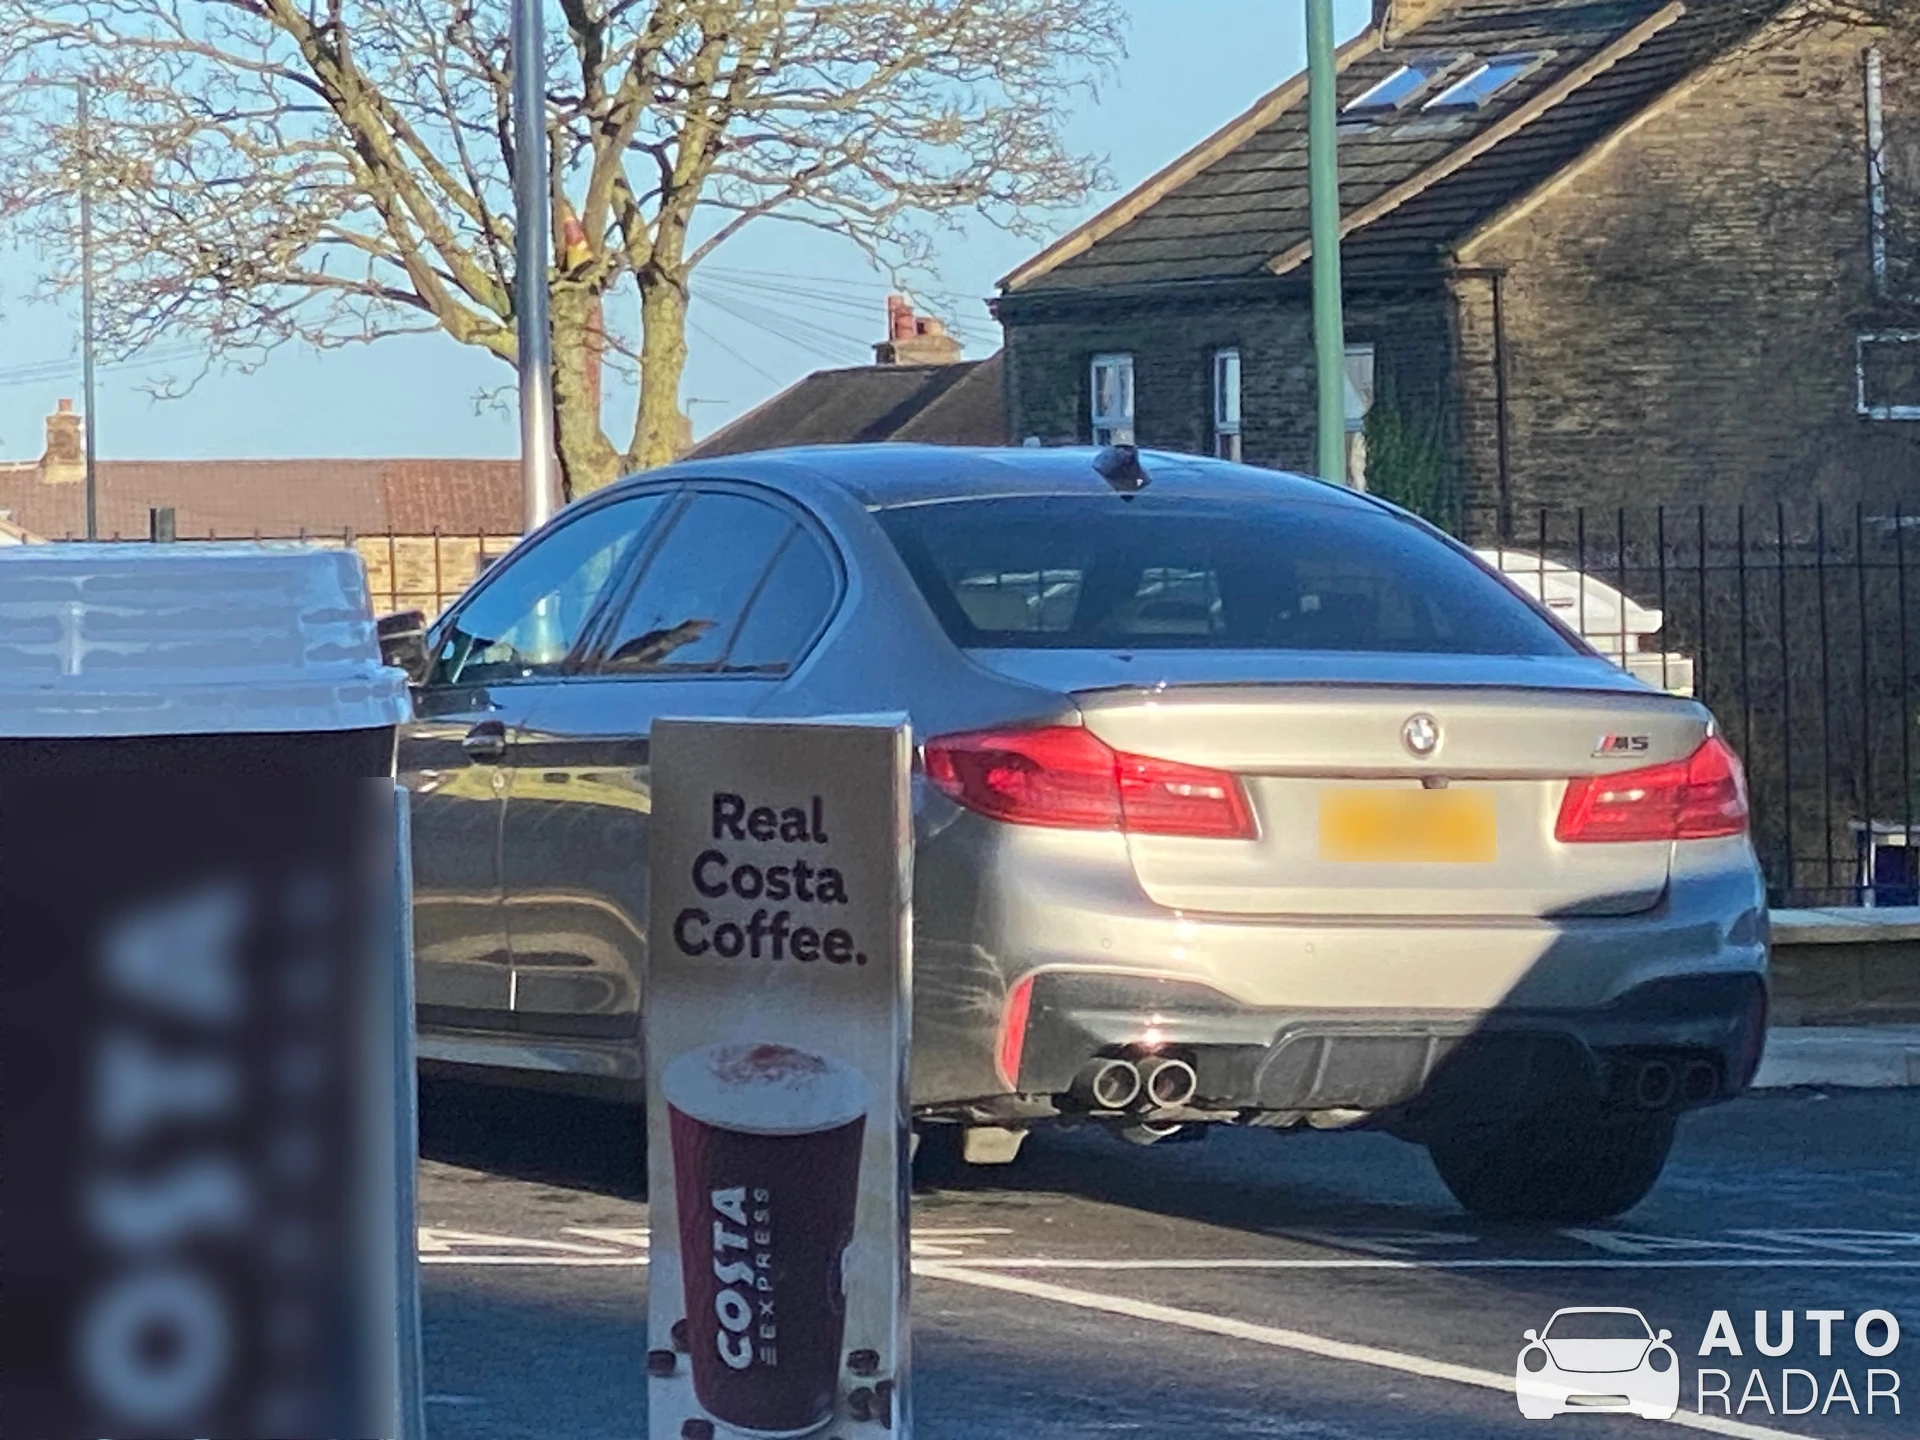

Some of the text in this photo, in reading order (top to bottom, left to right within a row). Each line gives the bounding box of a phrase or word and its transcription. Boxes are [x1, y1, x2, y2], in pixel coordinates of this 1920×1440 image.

[1609, 735, 1649, 750] M5
[711, 791, 828, 843] Real
[692, 849, 848, 904] Costa
[673, 907, 868, 965] Coffee.
[711, 1186, 754, 1369] COSTA
[753, 1187, 777, 1339] EXPRESS
